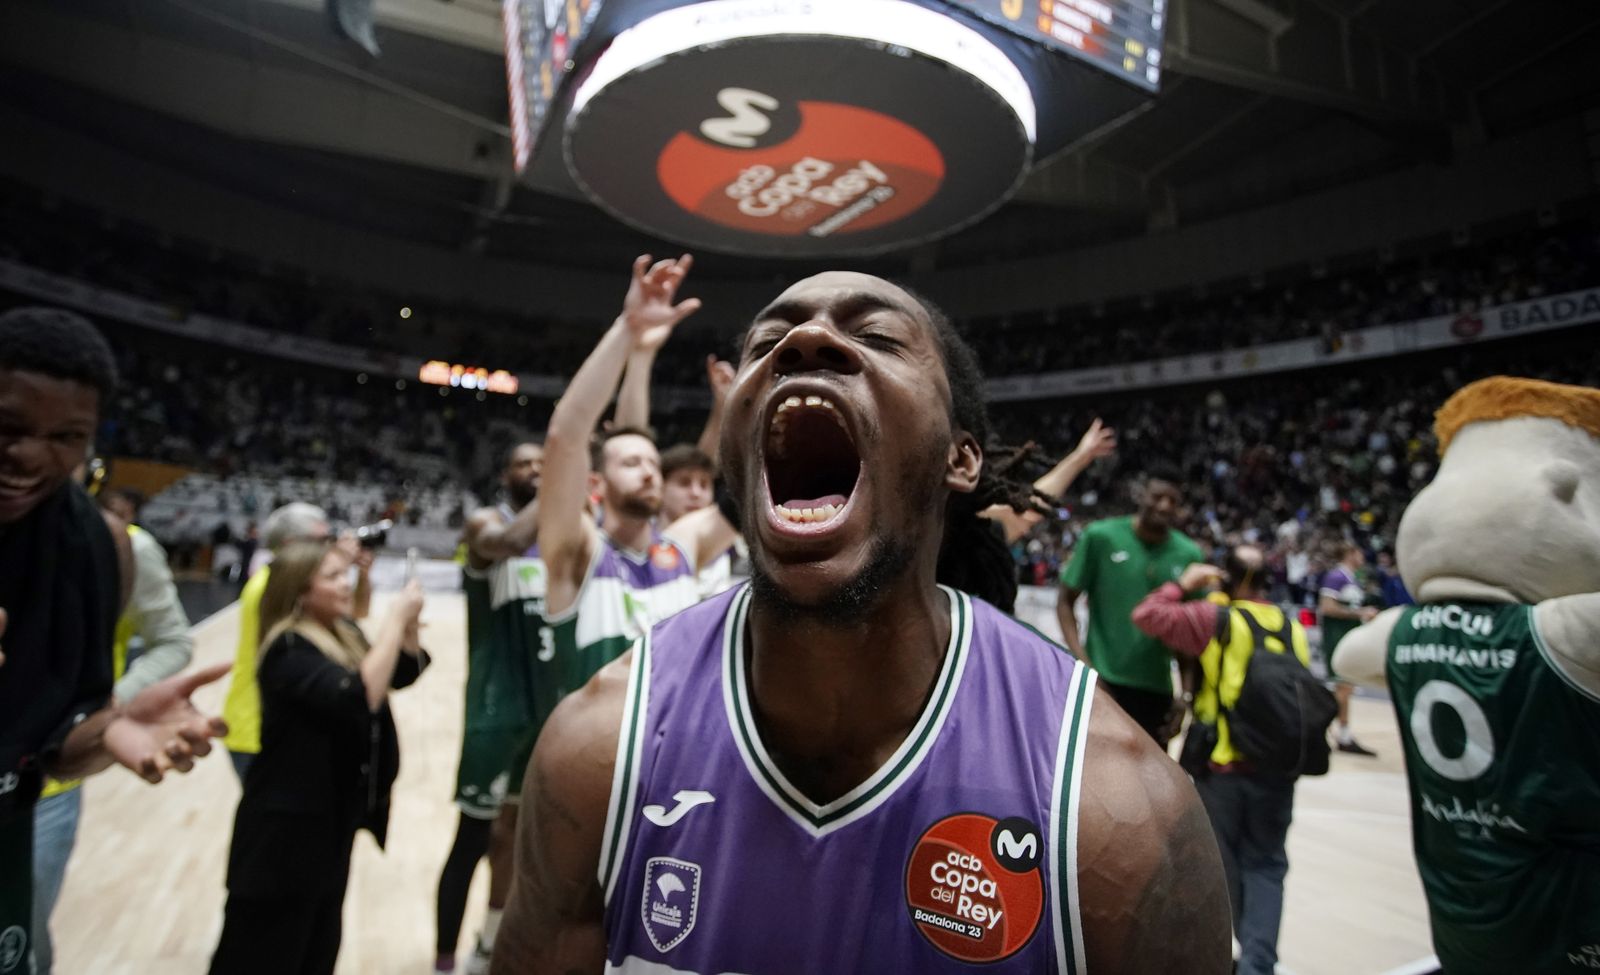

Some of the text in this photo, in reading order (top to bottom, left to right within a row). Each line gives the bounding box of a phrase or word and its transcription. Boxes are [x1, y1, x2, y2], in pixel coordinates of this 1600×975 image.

[738, 156, 835, 216] Copa
[809, 159, 888, 207] Rey
[537, 626, 555, 662] 3
[1410, 679, 1495, 781] 0
[947, 852, 982, 872] acb
[930, 862, 997, 899] Copa
[930, 886, 955, 904] del
[914, 909, 981, 938] Badalona '23
[956, 895, 1003, 930] Rey
